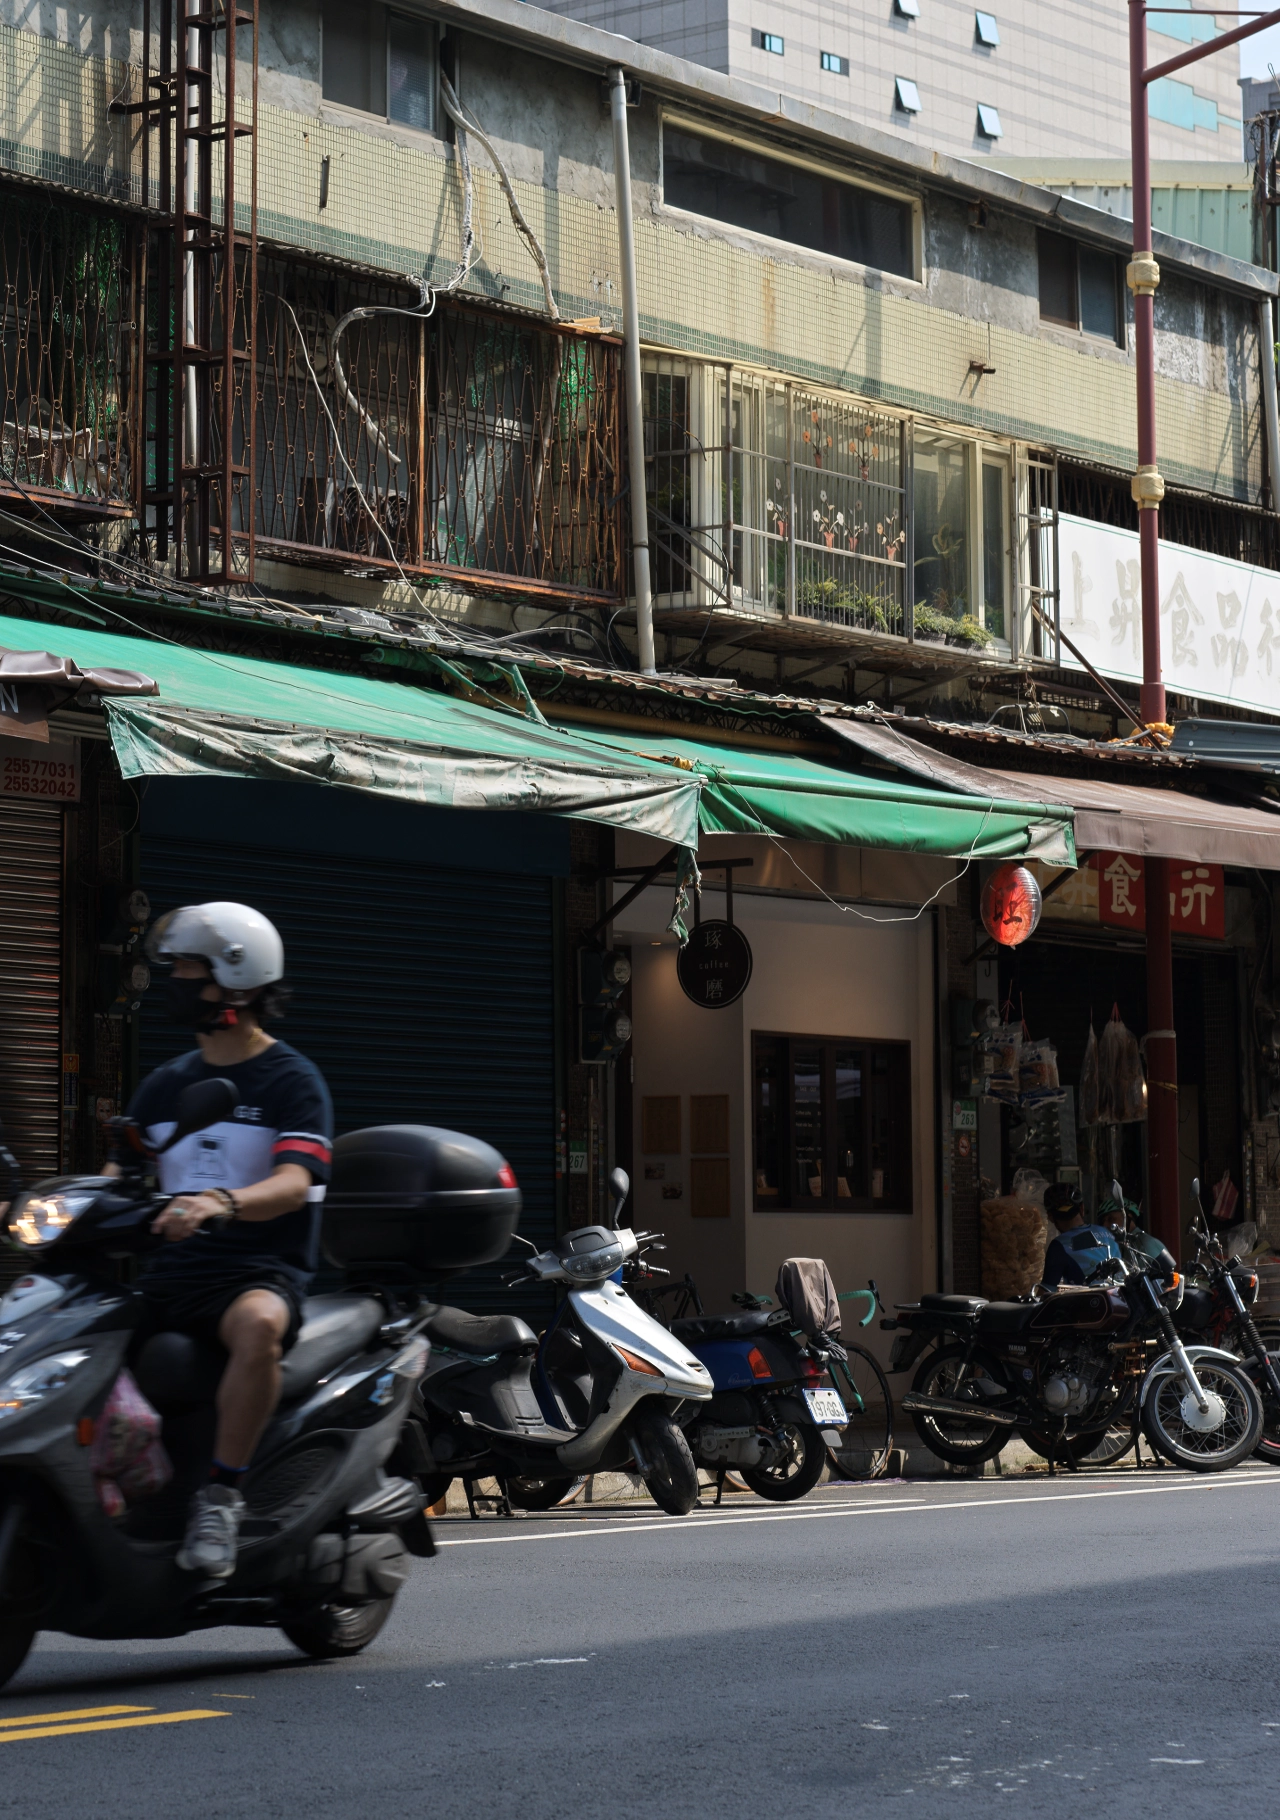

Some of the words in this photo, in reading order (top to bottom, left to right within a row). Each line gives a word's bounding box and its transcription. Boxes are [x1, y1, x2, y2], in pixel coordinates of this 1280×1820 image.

[4, 757, 75, 779] 25577031
[4, 775, 76, 797] 25532042
[698, 959, 729, 970] coffee
[960, 1113, 975, 1126] 263
[569, 1155, 585, 1169] 267
[1008, 1344, 1027, 1353] YAMAHA
